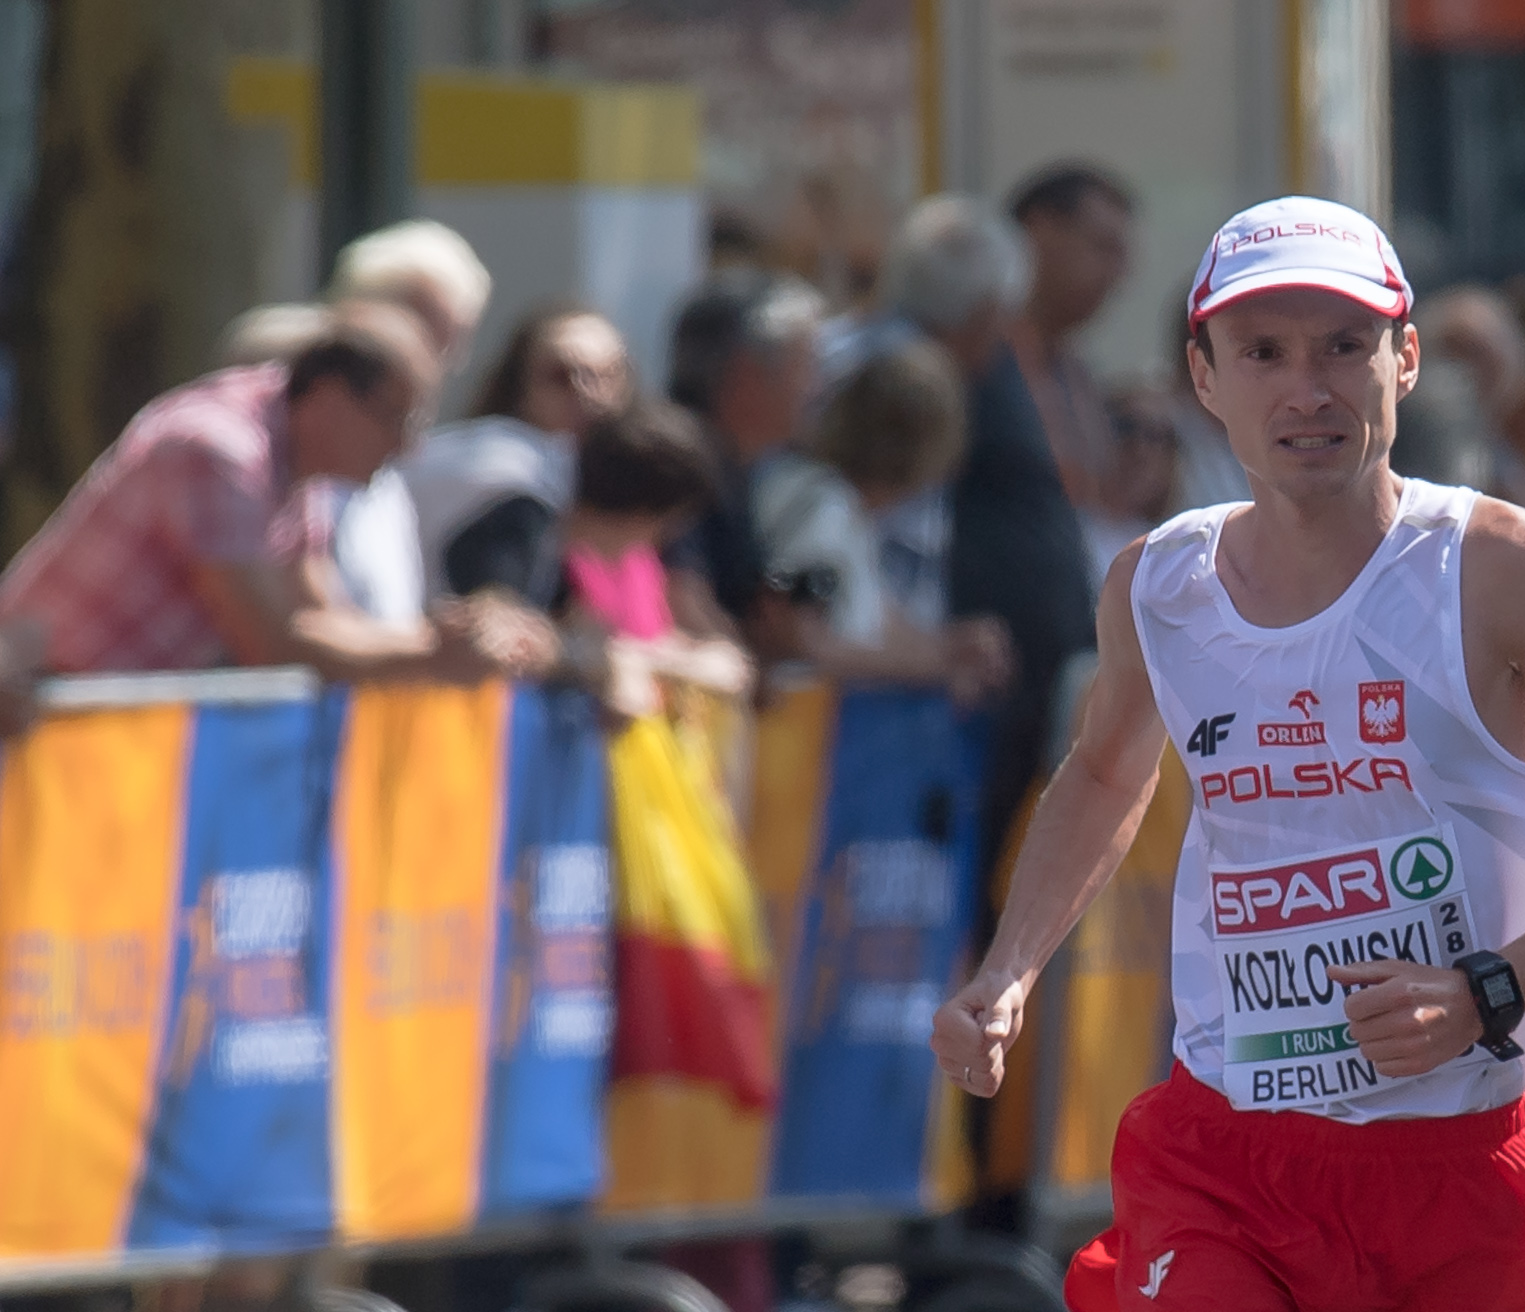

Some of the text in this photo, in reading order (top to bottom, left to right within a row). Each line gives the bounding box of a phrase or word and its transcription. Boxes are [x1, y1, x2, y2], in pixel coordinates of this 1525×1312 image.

[1232, 223, 1361, 253] POLSKA
[1361, 683, 1401, 693] POLSKA
[1186, 712, 1236, 757] 4F
[1201, 757, 1413, 809] POLSKA
[1216, 859, 1382, 925] SPAR
[1281, 1035, 1288, 1055] I
[1293, 1029, 1336, 1054] RUN
[1253, 1056, 1378, 1103] BERLIN
